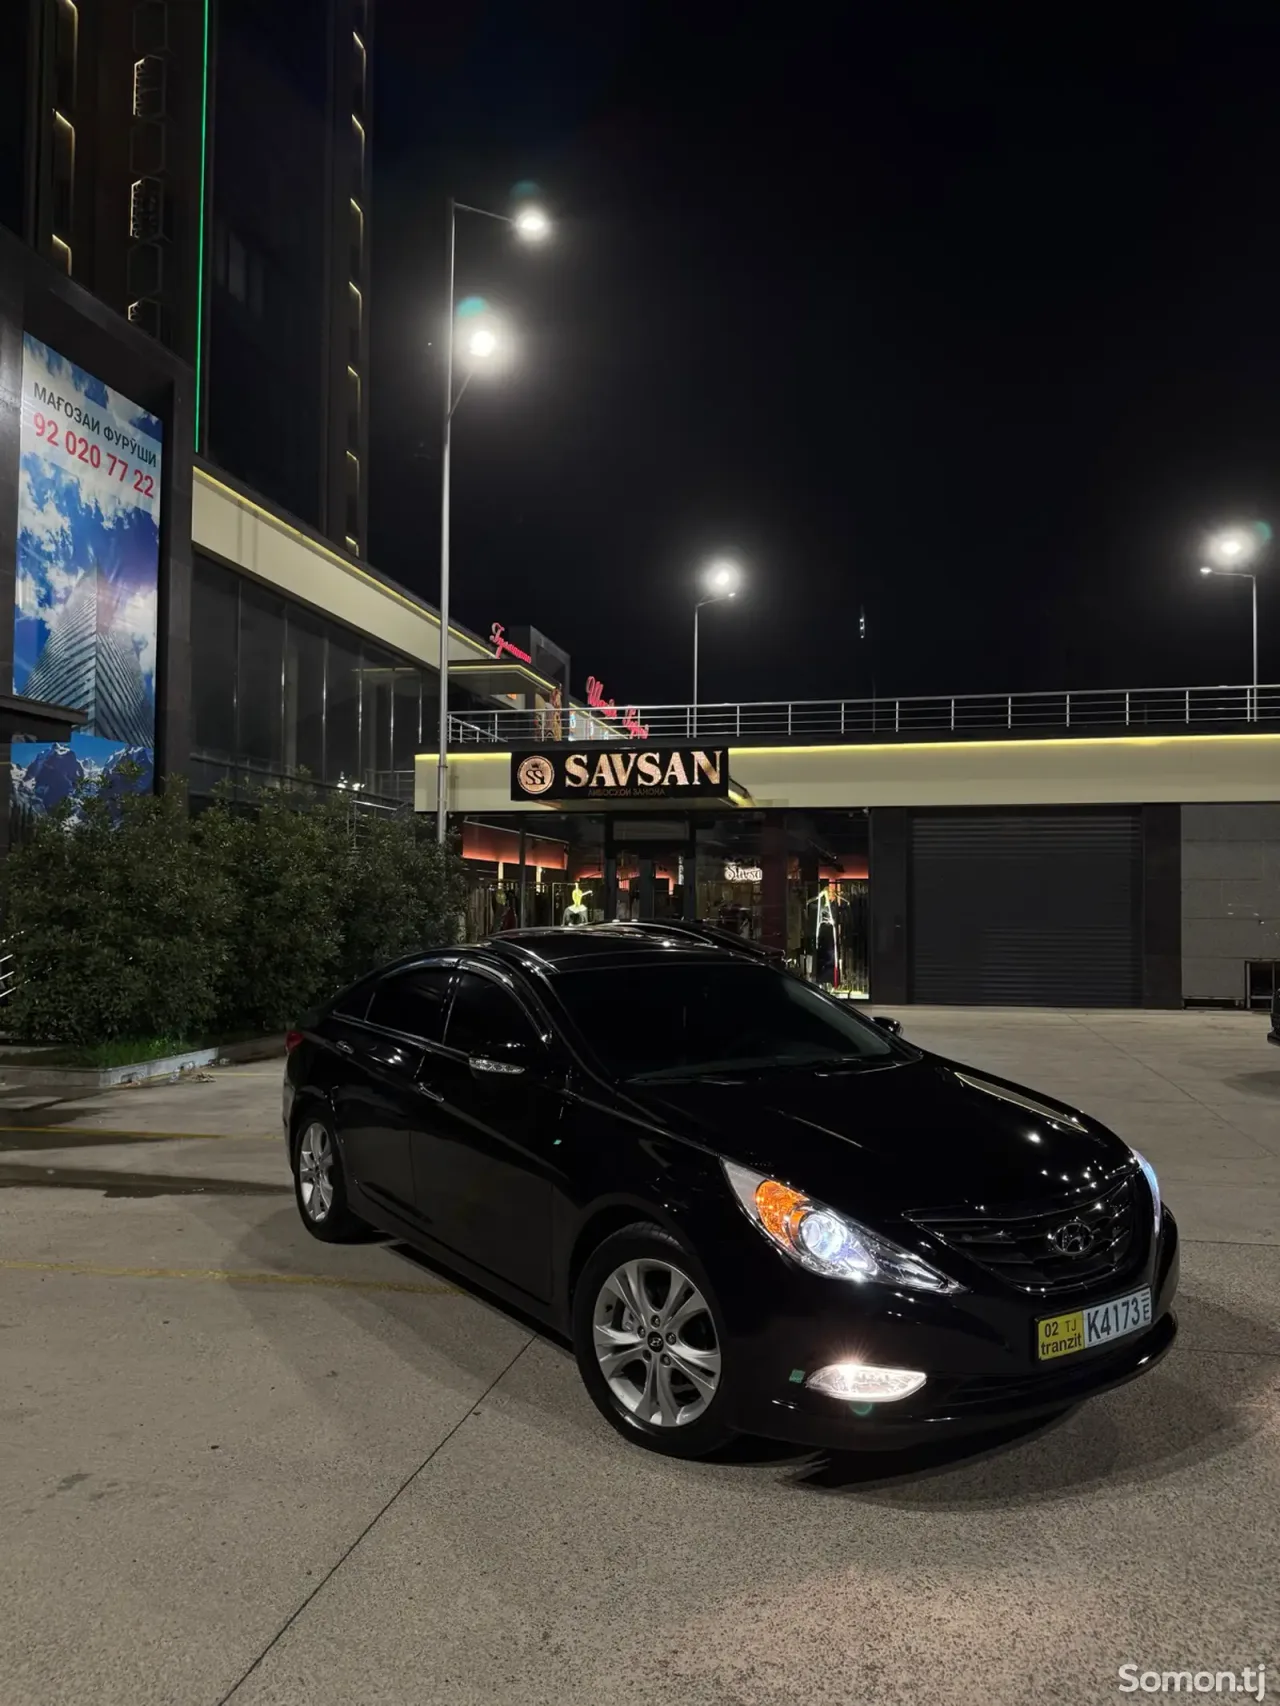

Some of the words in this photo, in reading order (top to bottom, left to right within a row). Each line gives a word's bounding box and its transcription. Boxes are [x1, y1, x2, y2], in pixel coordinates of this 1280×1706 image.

[34, 382, 100, 435] МАҒОЗАИ
[33, 412, 59, 447] 92
[65, 430, 100, 469] 020
[106, 452, 129, 482] 77
[133, 469, 155, 499] 22
[564, 750, 723, 788] SAVSAN
[1044, 1322, 1059, 1338] 02
[1065, 1319, 1077, 1333] TJ
[1087, 1296, 1140, 1343] K4173
[1041, 1333, 1082, 1356] tranzit
